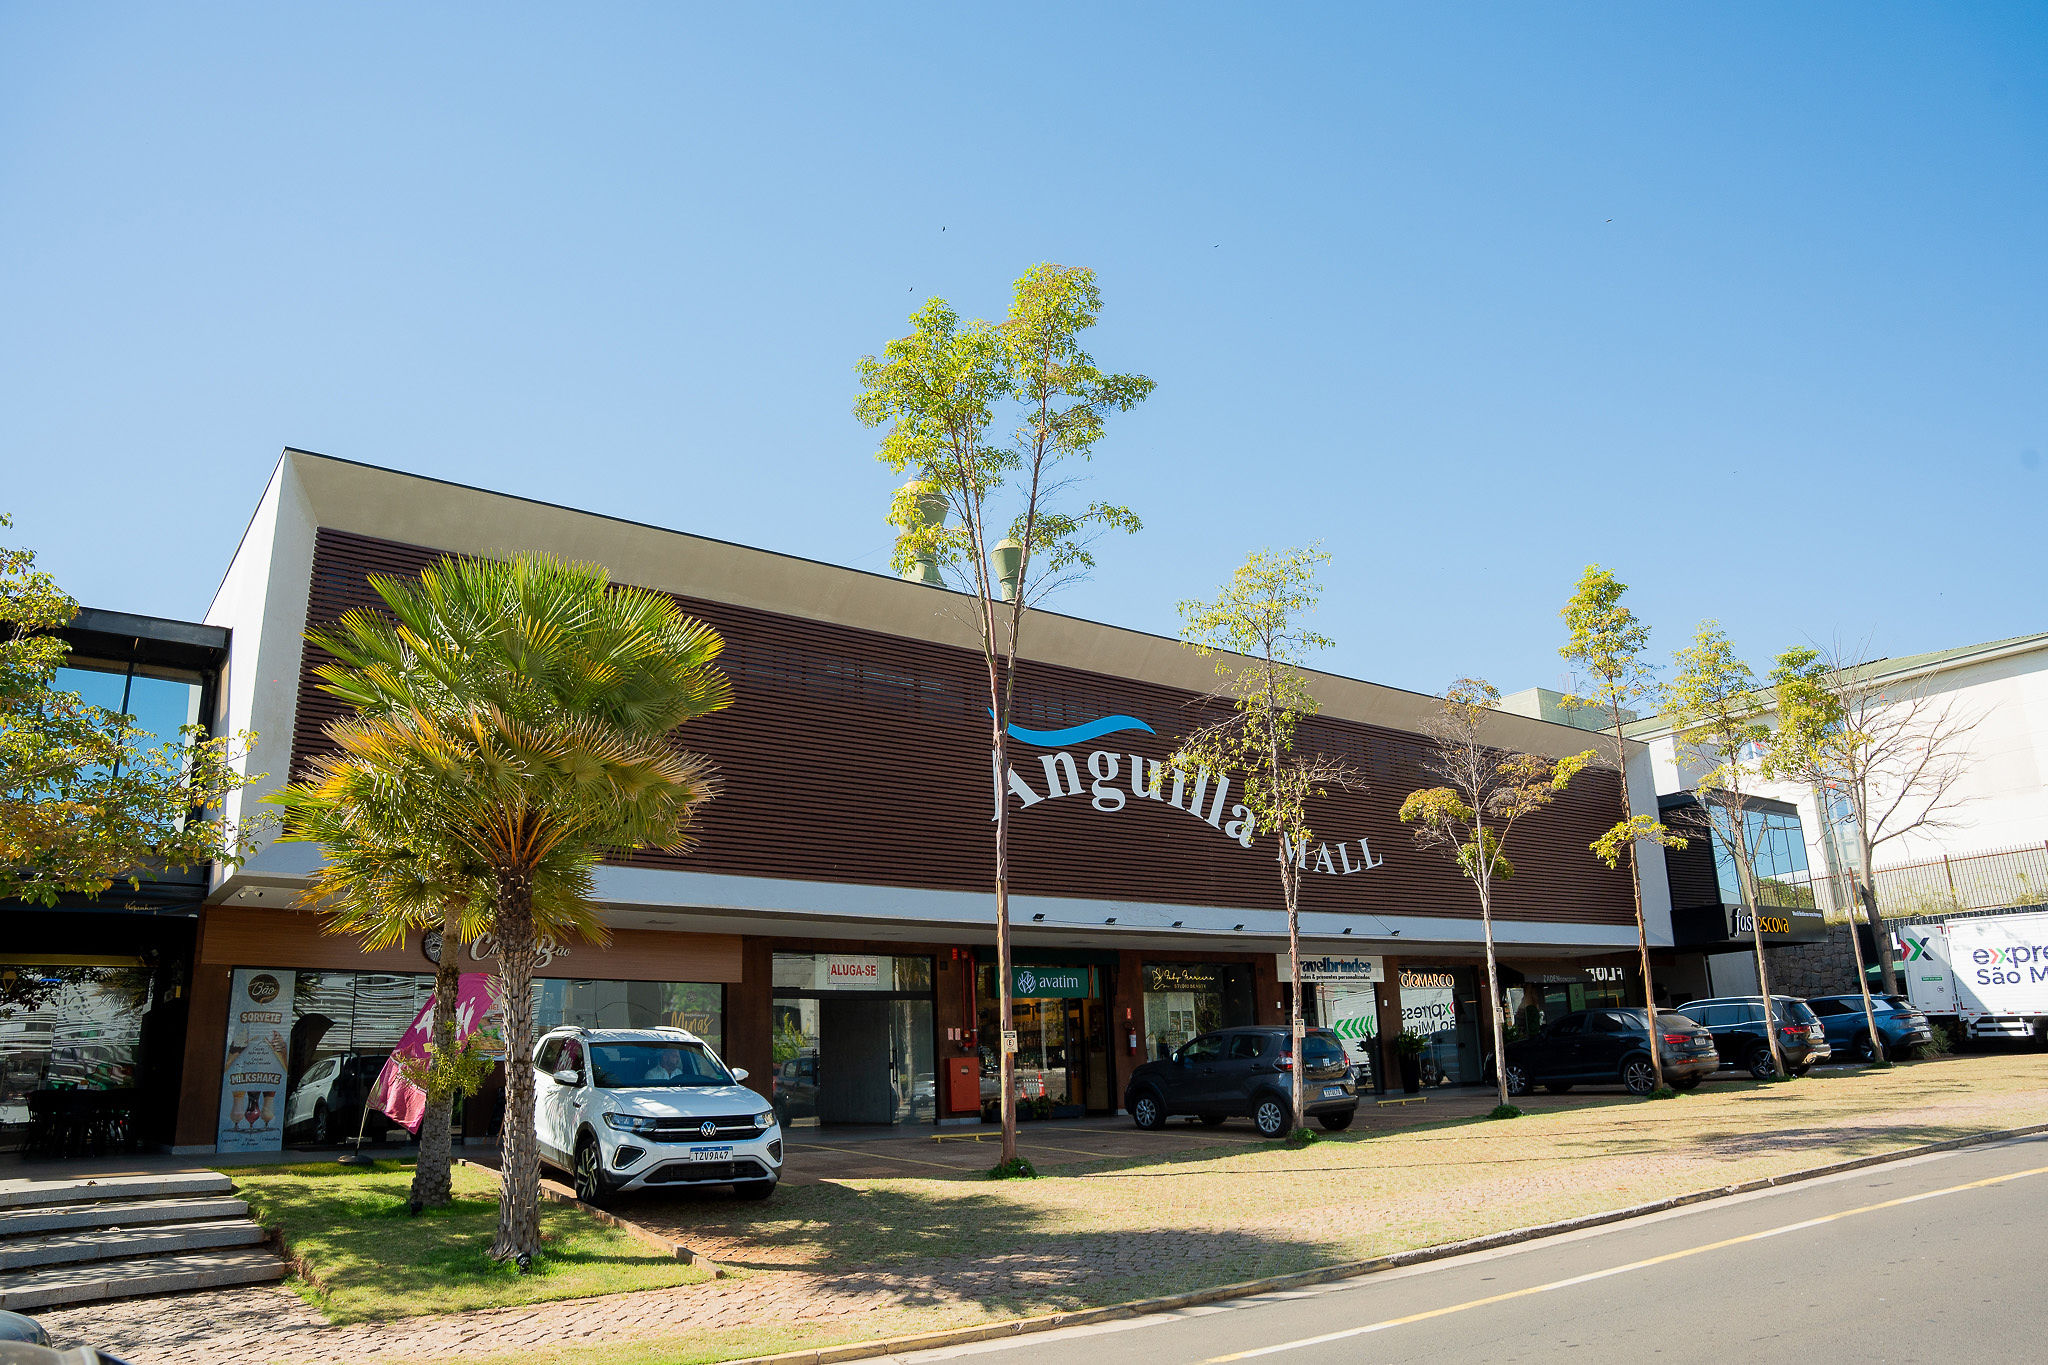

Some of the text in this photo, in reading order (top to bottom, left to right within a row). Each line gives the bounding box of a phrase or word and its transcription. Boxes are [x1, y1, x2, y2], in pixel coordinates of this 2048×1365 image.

[992, 750, 1256, 848] Anguilla
[1276, 831, 1383, 875] MALL
[831, 964, 876, 976] ALUGA-SE
[1300, 957, 1371, 973] ravelbrindes
[1039, 975, 1079, 988] avatim
[1977, 967, 2021, 985] São
[241, 1012, 282, 1023] SORVETE
[671, 1011, 714, 1034] Minas
[230, 1072, 281, 1084] MILKSHAKE
